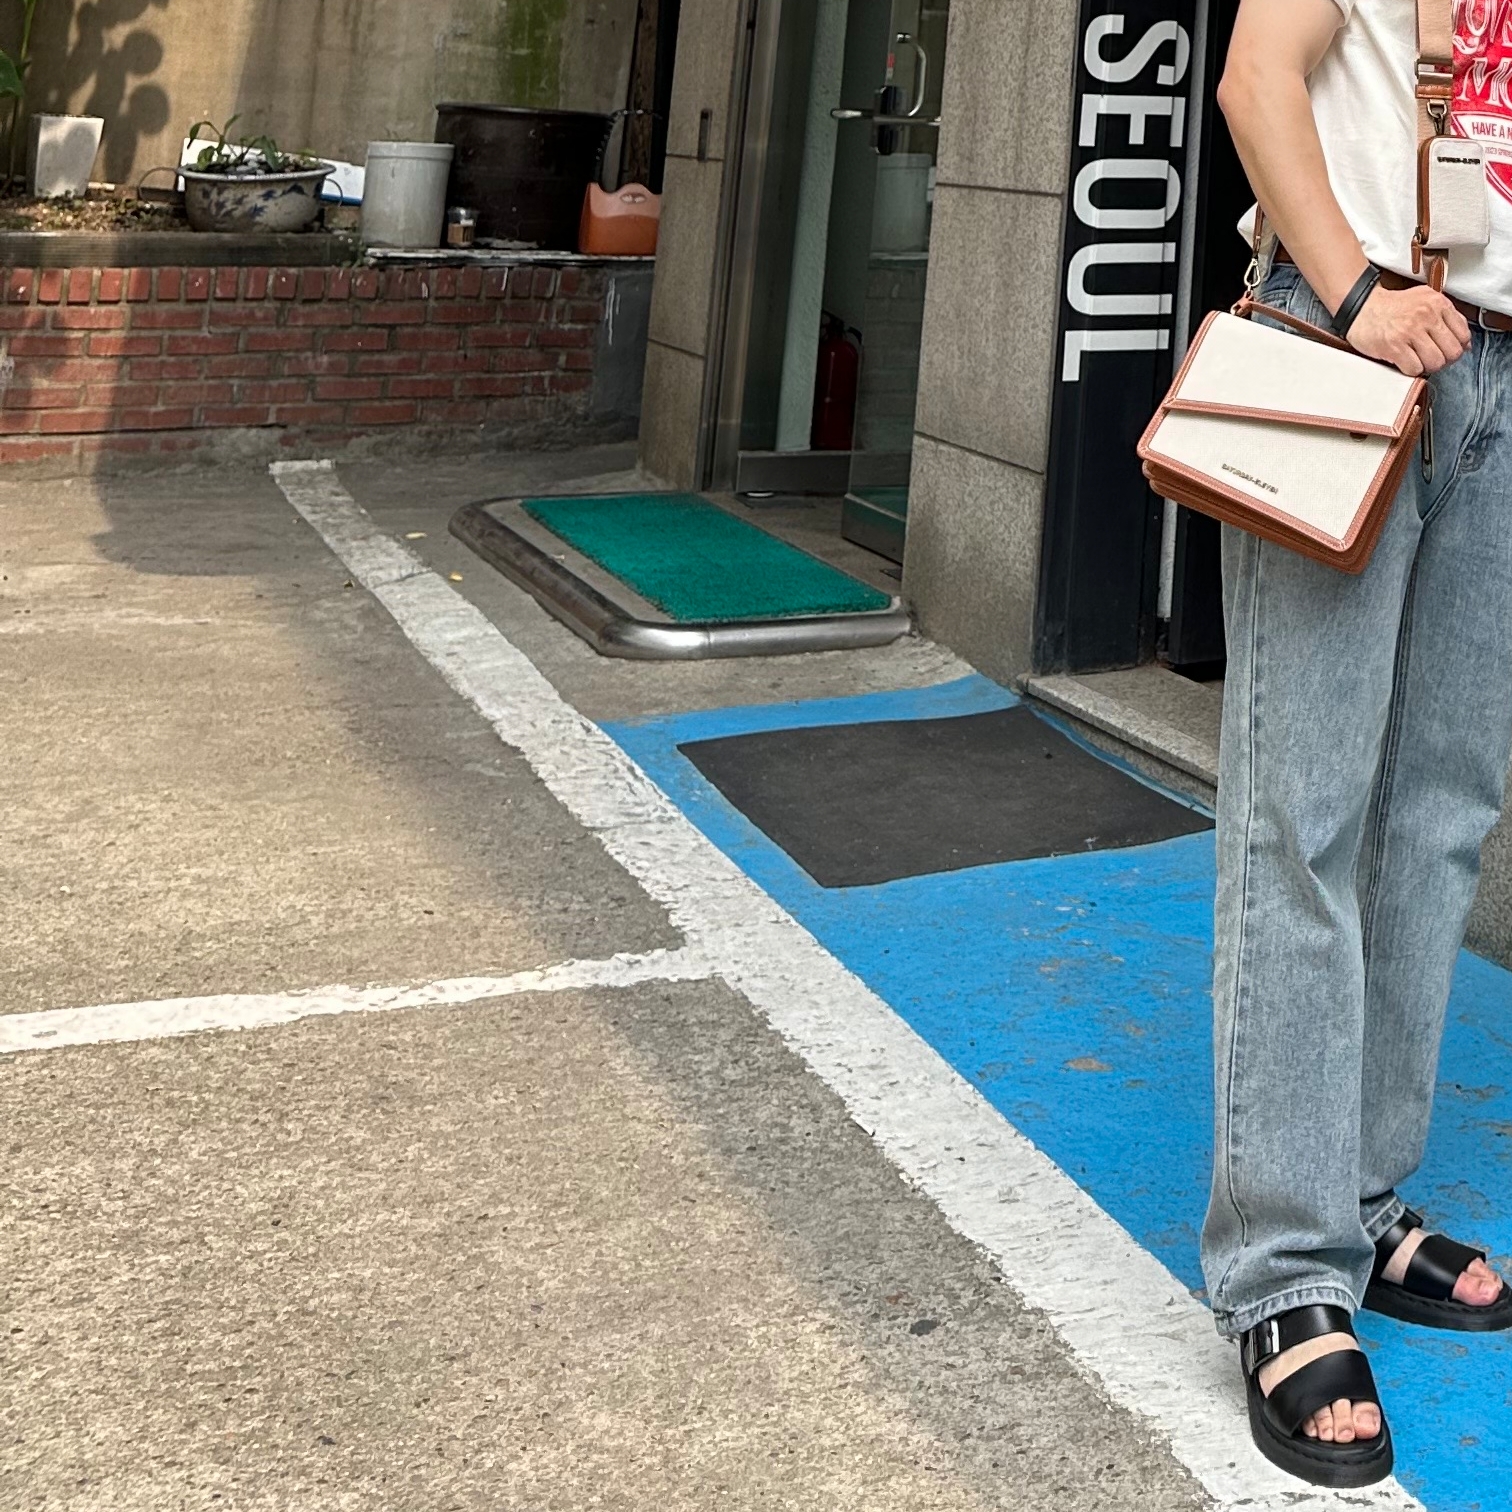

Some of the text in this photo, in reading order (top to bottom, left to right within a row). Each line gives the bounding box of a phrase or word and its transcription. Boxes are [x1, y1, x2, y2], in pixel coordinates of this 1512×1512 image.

[1061, 13, 1191, 383] SEOUL
[1472, 122, 1497, 137] HAVE
[1499, 125, 1506, 138] A
